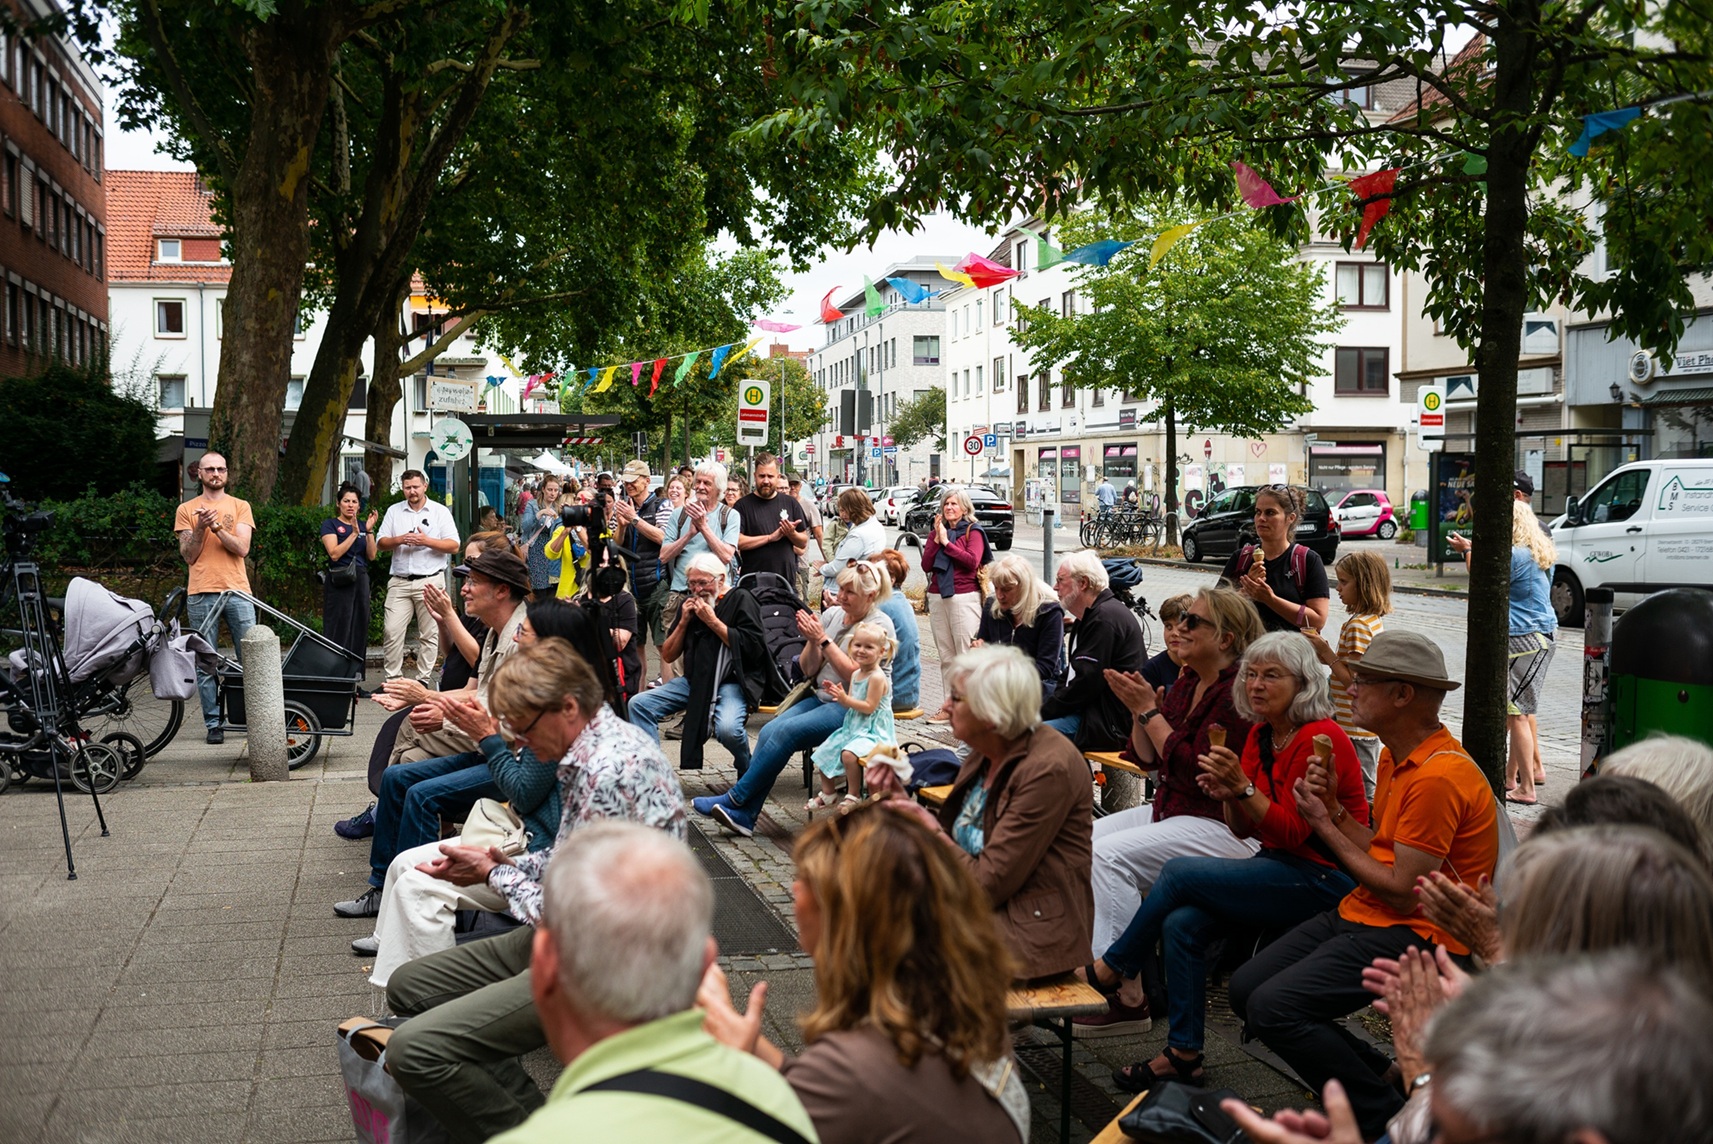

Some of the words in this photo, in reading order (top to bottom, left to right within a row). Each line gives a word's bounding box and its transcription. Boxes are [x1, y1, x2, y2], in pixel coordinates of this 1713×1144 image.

[968, 441, 980, 450] 30
[1447, 480, 1465, 488] NEUE
[1681, 503, 1709, 512] Service
